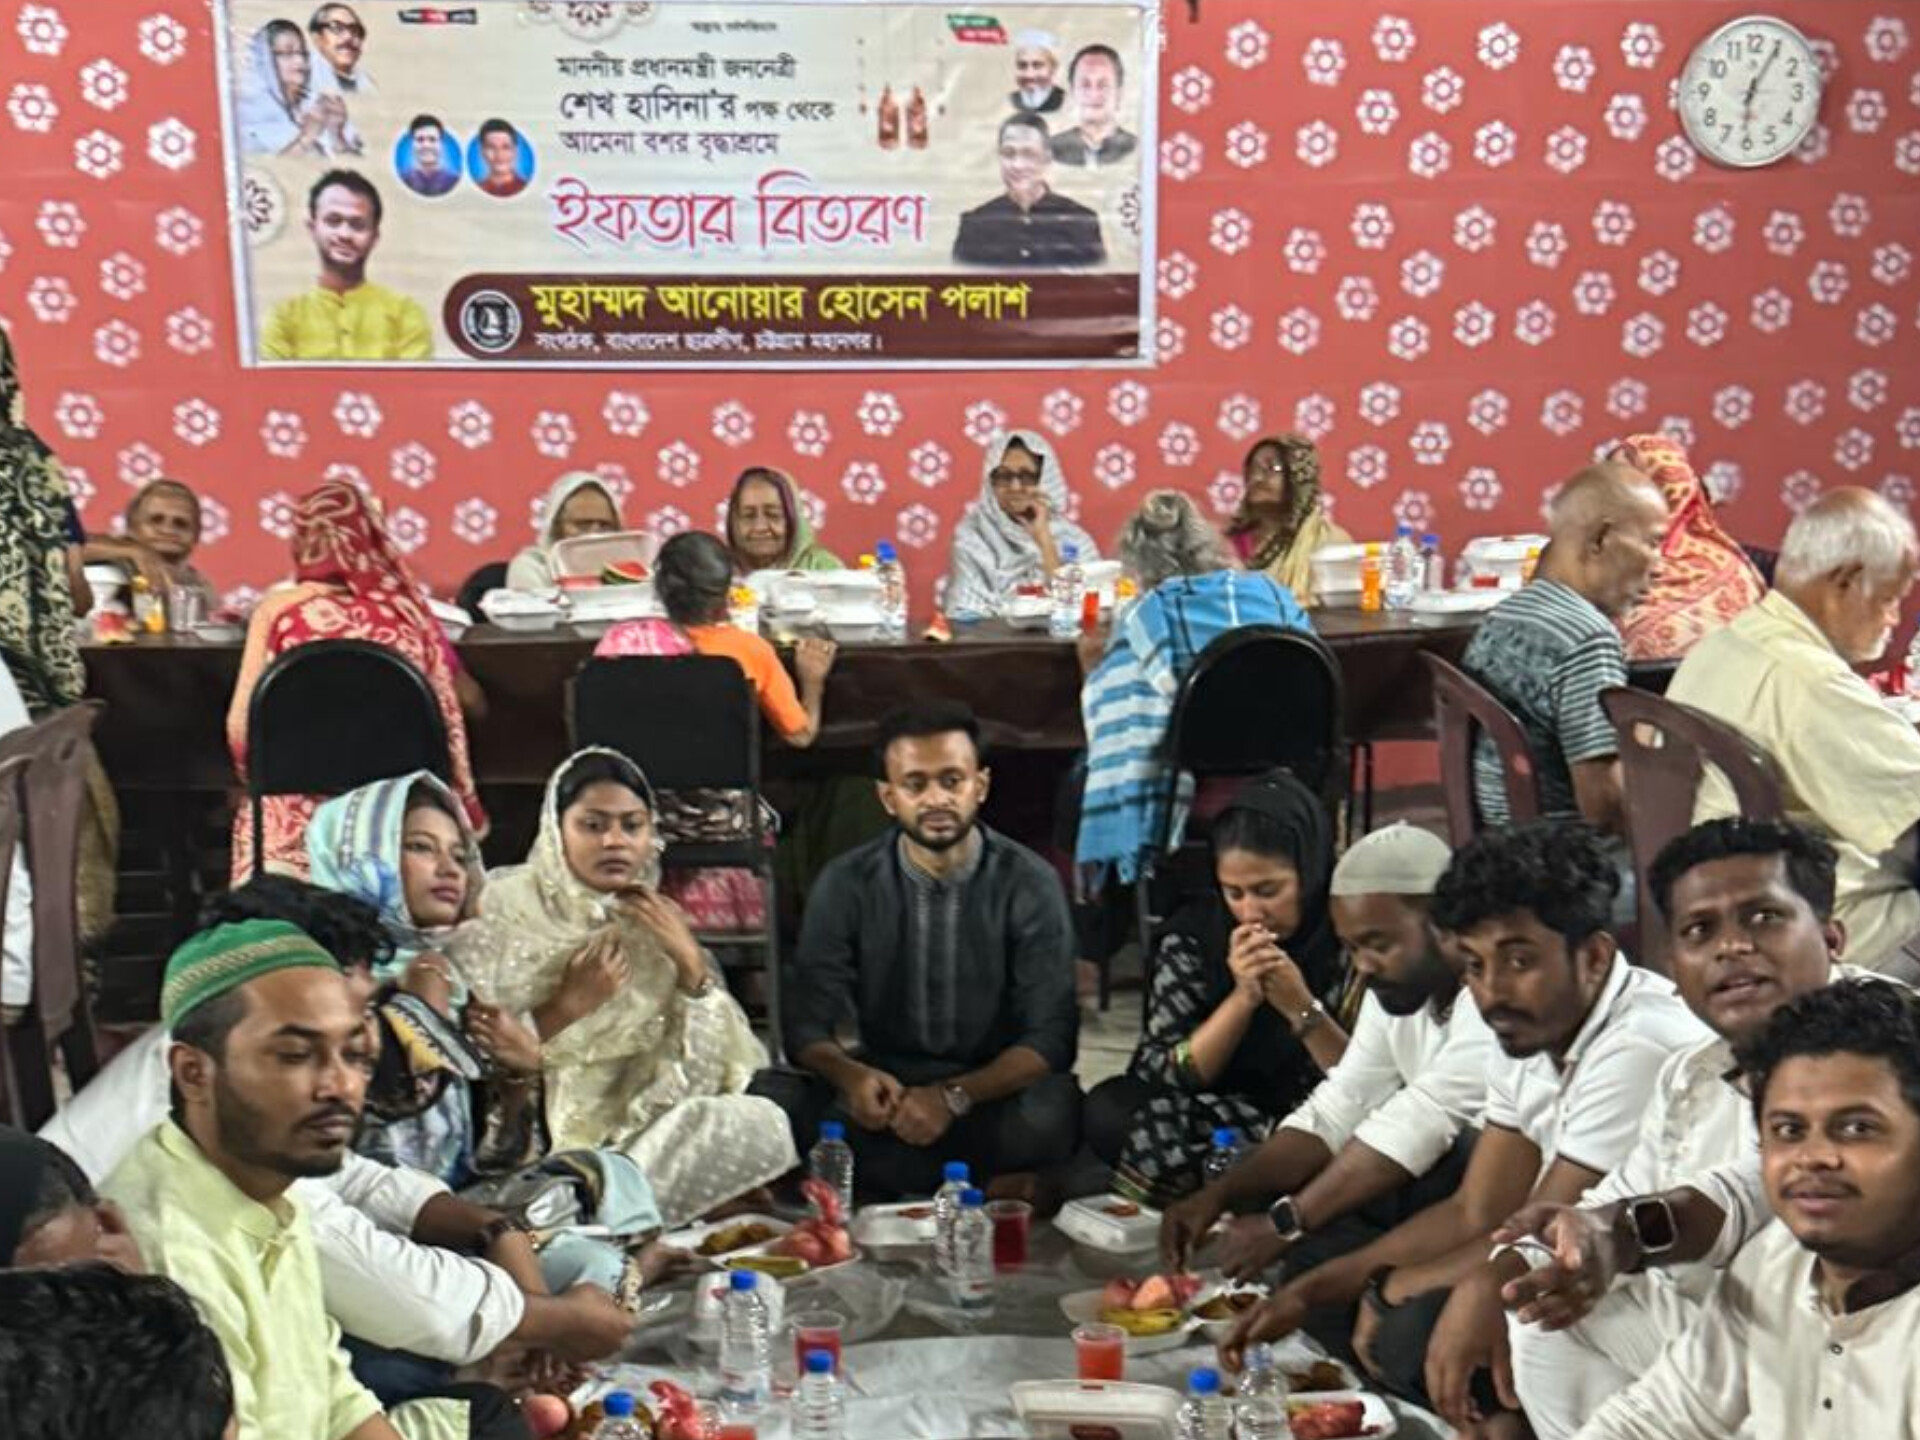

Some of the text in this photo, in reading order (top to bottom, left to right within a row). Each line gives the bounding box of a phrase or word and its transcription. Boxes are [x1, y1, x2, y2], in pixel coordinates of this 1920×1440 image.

[1727, 41, 1741, 61] 11
[1747, 34, 1764, 52] 12
[556, 51, 796, 78] মাননীয় প্রধানমন্ত্রী জননেত্রী
[1709, 59, 1727, 78] 10
[1786, 57, 1799, 77] 2
[1698, 82, 1711, 101] 9
[1791, 83, 1803, 102] 3
[560, 90, 615, 119] শেখ
[786, 101, 835, 120] থেকে
[1704, 107, 1716, 126] 8
[1782, 108, 1793, 124] 4
[559, 131, 635, 153] আমেনা
[643, 132, 690, 153] বশর
[1720, 124, 1733, 143] 7
[1764, 125, 1776, 145] 5
[550, 169, 926, 249] ইফতার বিতরণ
[530, 282, 1032, 328] মুহাম্মদ আনোয়ার হোসেন পলাশ
